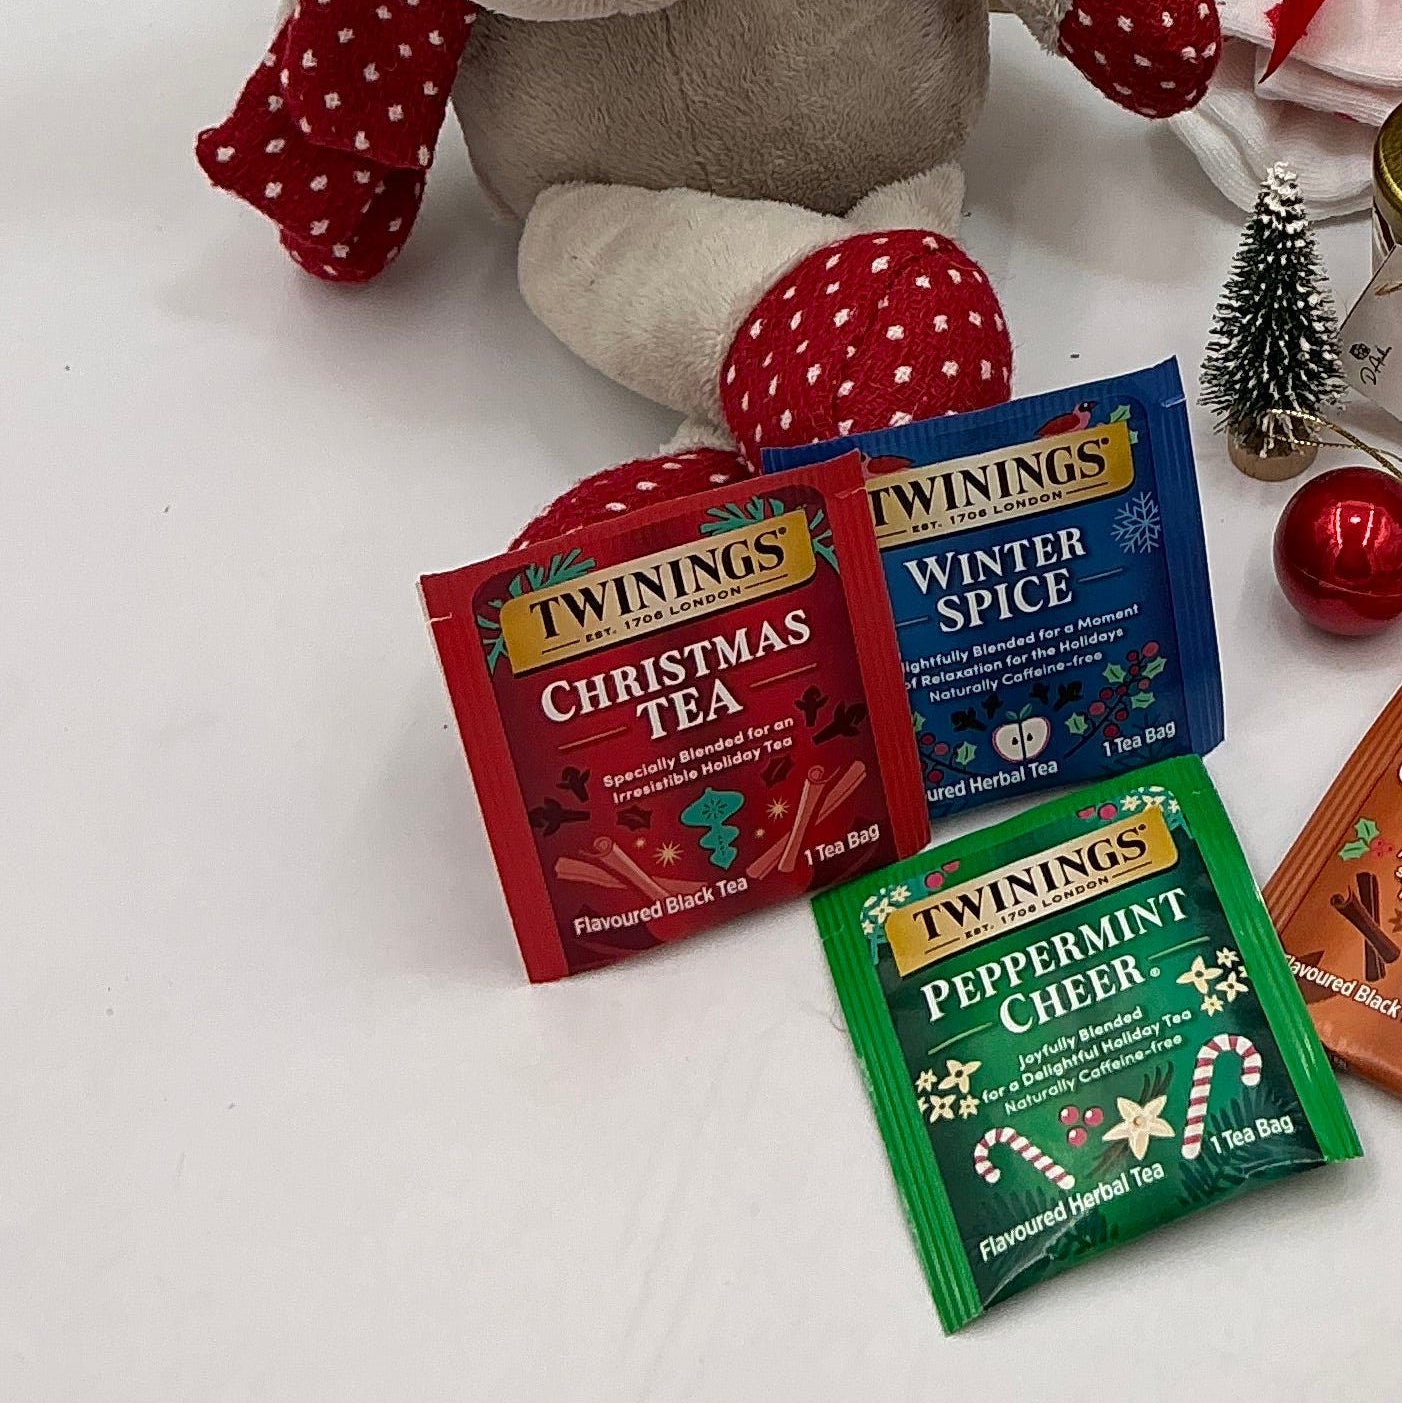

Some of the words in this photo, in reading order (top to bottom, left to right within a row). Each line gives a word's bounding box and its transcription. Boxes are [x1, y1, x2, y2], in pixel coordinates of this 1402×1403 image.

[868, 439, 1105, 527] TWININGS
[949, 508, 988, 526] 1706
[993, 491, 1063, 515] LONDON
[530, 529, 786, 640] TWININGS
[903, 527, 1087, 595] WINTER
[669, 585, 742, 616] LONDON
[936, 568, 1073, 633] SPICE
[541, 608, 811, 723] CHRISTMAS
[902, 649, 970, 674] lightfully
[972, 632, 1036, 658] Blended
[1038, 625, 1061, 641] for
[1077, 603, 1140, 632] Moment
[921, 660, 1004, 687] Relaxation
[1005, 650, 1030, 667] for
[1031, 644, 1057, 661] the
[1058, 627, 1124, 653] Holidays
[636, 678, 744, 741] TEA
[929, 677, 999, 704] Naturally
[1001, 651, 1104, 685] Caffeine-free
[602, 755, 676, 788] Specially
[678, 730, 745, 765] Blended
[747, 723, 770, 741] for
[773, 716, 794, 732] an
[612, 767, 699, 805] Irresistible
[702, 747, 761, 777] Holiday
[763, 735, 794, 754] Tea
[1113, 734, 1143, 754] Tea
[1144, 720, 1177, 745] Bag
[969, 766, 1026, 795] Herbal
[1030, 760, 1060, 780] Tea
[815, 841, 846, 863] Tea
[846, 823, 880, 850] Bag
[572, 899, 663, 937] Flavoured
[665, 885, 715, 915] Black
[715, 875, 749, 898] Tea
[913, 826, 1148, 942] TWININGS
[1041, 876, 1109, 908] LONDON
[920, 887, 1188, 1024] PEPPERMINT
[1353, 982, 1402, 1019] Black
[982, 1085, 1006, 1104] for
[1021, 1043, 1100, 1088] Delightful
[1100, 1021, 1161, 1054] Holiday
[1162, 1009, 1193, 1028] Tea
[1018, 1035, 1077, 1072] Joyfully
[1078, 1005, 1143, 1042] Blended
[1004, 1077, 1078, 1117] Naturally
[1078, 1034, 1184, 1084] Caffeine-free
[1221, 1127, 1256, 1150] Tea
[1254, 1113, 1295, 1139] Bag
[979, 1201, 1068, 1263] Flavoured
[1068, 1172, 1132, 1217] Herbal
[1130, 1161, 1166, 1188] Tea
